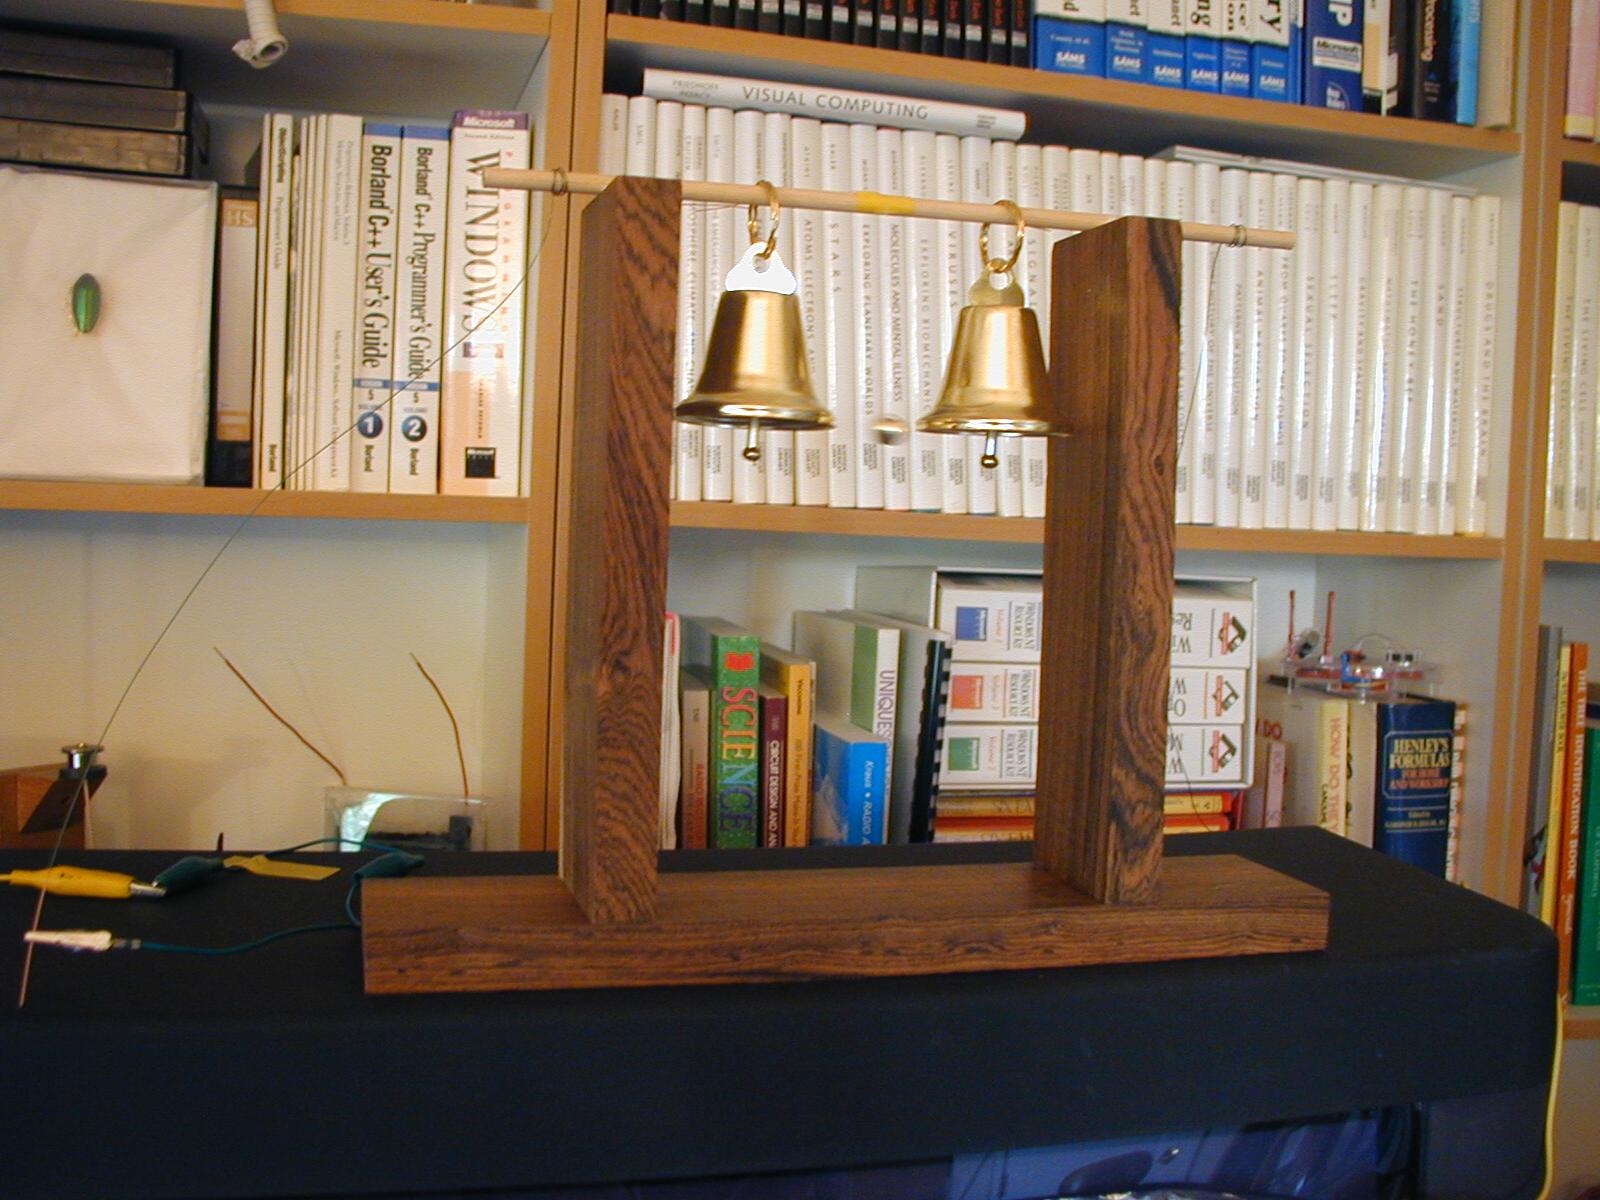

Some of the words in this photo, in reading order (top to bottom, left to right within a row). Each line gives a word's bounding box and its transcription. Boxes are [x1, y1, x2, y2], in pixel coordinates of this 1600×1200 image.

[1056, 51, 1086, 65] SAMS
[1112, 55, 1141, 69] SAMS
[1316, 40, 1360, 53] Microsoft
[1154, 64, 1183, 78] SAMS
[1191, 68, 1218, 81] SAMS
[1222, 70, 1249, 84] SAMS
[1260, 74, 1286, 88] SAMS
[742, 86, 807, 106] VISUAL
[816, 94, 930, 119] COMPUTING
[464, 115, 516, 129] Microsoft
[370, 145, 393, 211] Borland
[415, 147, 433, 197] Borland
[367, 215, 390, 248] C++
[414, 203, 431, 228] C++
[831, 221, 842, 293] STARS
[862, 224, 873, 290] EXPLORING
[890, 223, 902, 288] MOLECULES
[948, 231, 959, 309] VIRUSES
[364, 253, 392, 308] User's
[406, 232, 437, 333] Programmer's
[891, 289, 902, 315] AND
[361, 313, 390, 368] Guide
[892, 317, 903, 358] MENTAL
[408, 337, 433, 380] Guide
[864, 366, 875, 416] WORLDS
[893, 359, 904, 403] ILLNESS
[269, 445, 278, 472] Borland
[364, 445, 375, 472] Borland
[409, 448, 420, 476] Borland
[1578, 670, 1588, 692] THE
[1576, 697, 1587, 728] TREE
[1329, 719, 1342, 758] HOW
[1394, 737, 1450, 753] HENLEY'S
[719, 686, 758, 834] SCIENCE
[768, 739, 780, 775] CIRCUIT
[1388, 752, 1451, 769] FORMULAS
[864, 760, 875, 788] Kraus
[1330, 765, 1341, 789] DO
[1570, 733, 1585, 834] IDENTIFICATION
[768, 776, 780, 809] DESIGN
[768, 810, 778, 831] AND
[862, 801, 873, 835] RADIO
[1567, 839, 1580, 881] BOOK
